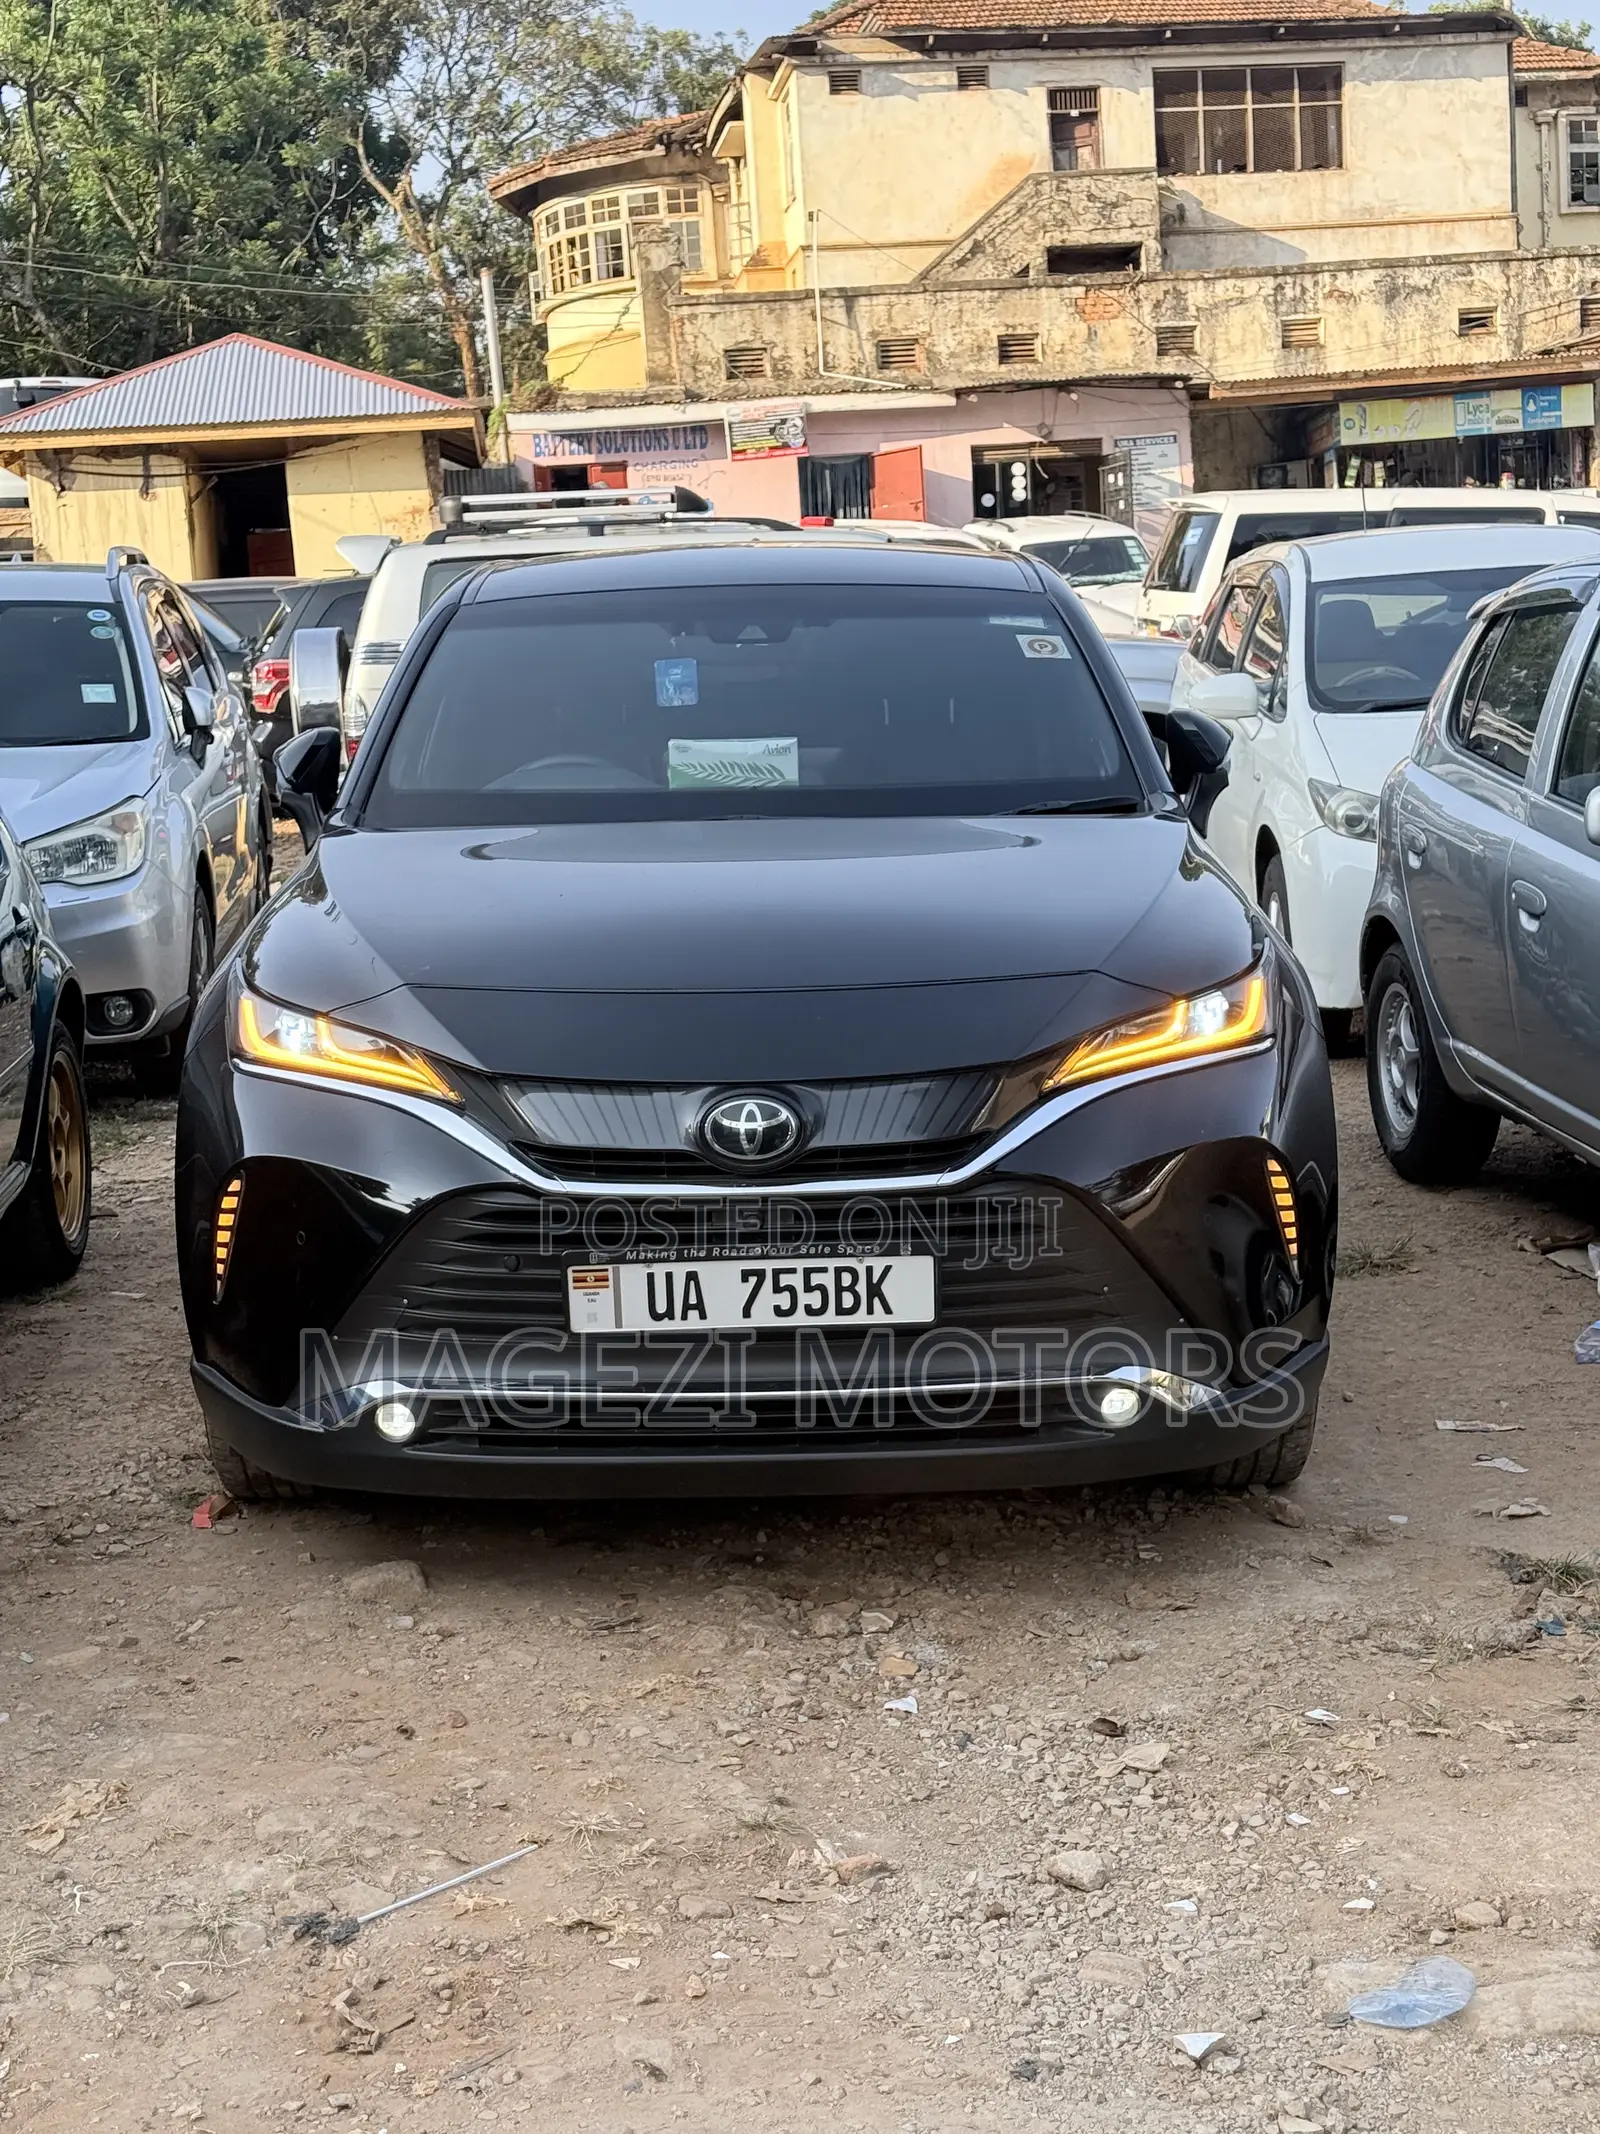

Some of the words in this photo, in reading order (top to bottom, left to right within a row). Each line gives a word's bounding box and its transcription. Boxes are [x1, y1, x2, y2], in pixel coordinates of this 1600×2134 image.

[1467, 402, 1490, 416] Lyca
[596, 427, 669, 454] SOLUTIONS
[684, 425, 709, 450] LTD
[1136, 436, 1175, 445] SERVICES
[633, 457, 699, 472] CHARGING
[762, 744, 792, 755] Avion
[626, 1250, 677, 1261] Making
[684, 1248, 706, 1258] the
[712, 1245, 755, 1257] Roads
[761, 1245, 794, 1256] Your
[800, 1244, 832, 1254] Safe
[837, 1243, 881, 1255] Space
[646, 1270, 708, 1322] UA
[740, 1264, 893, 1319] 755BK
